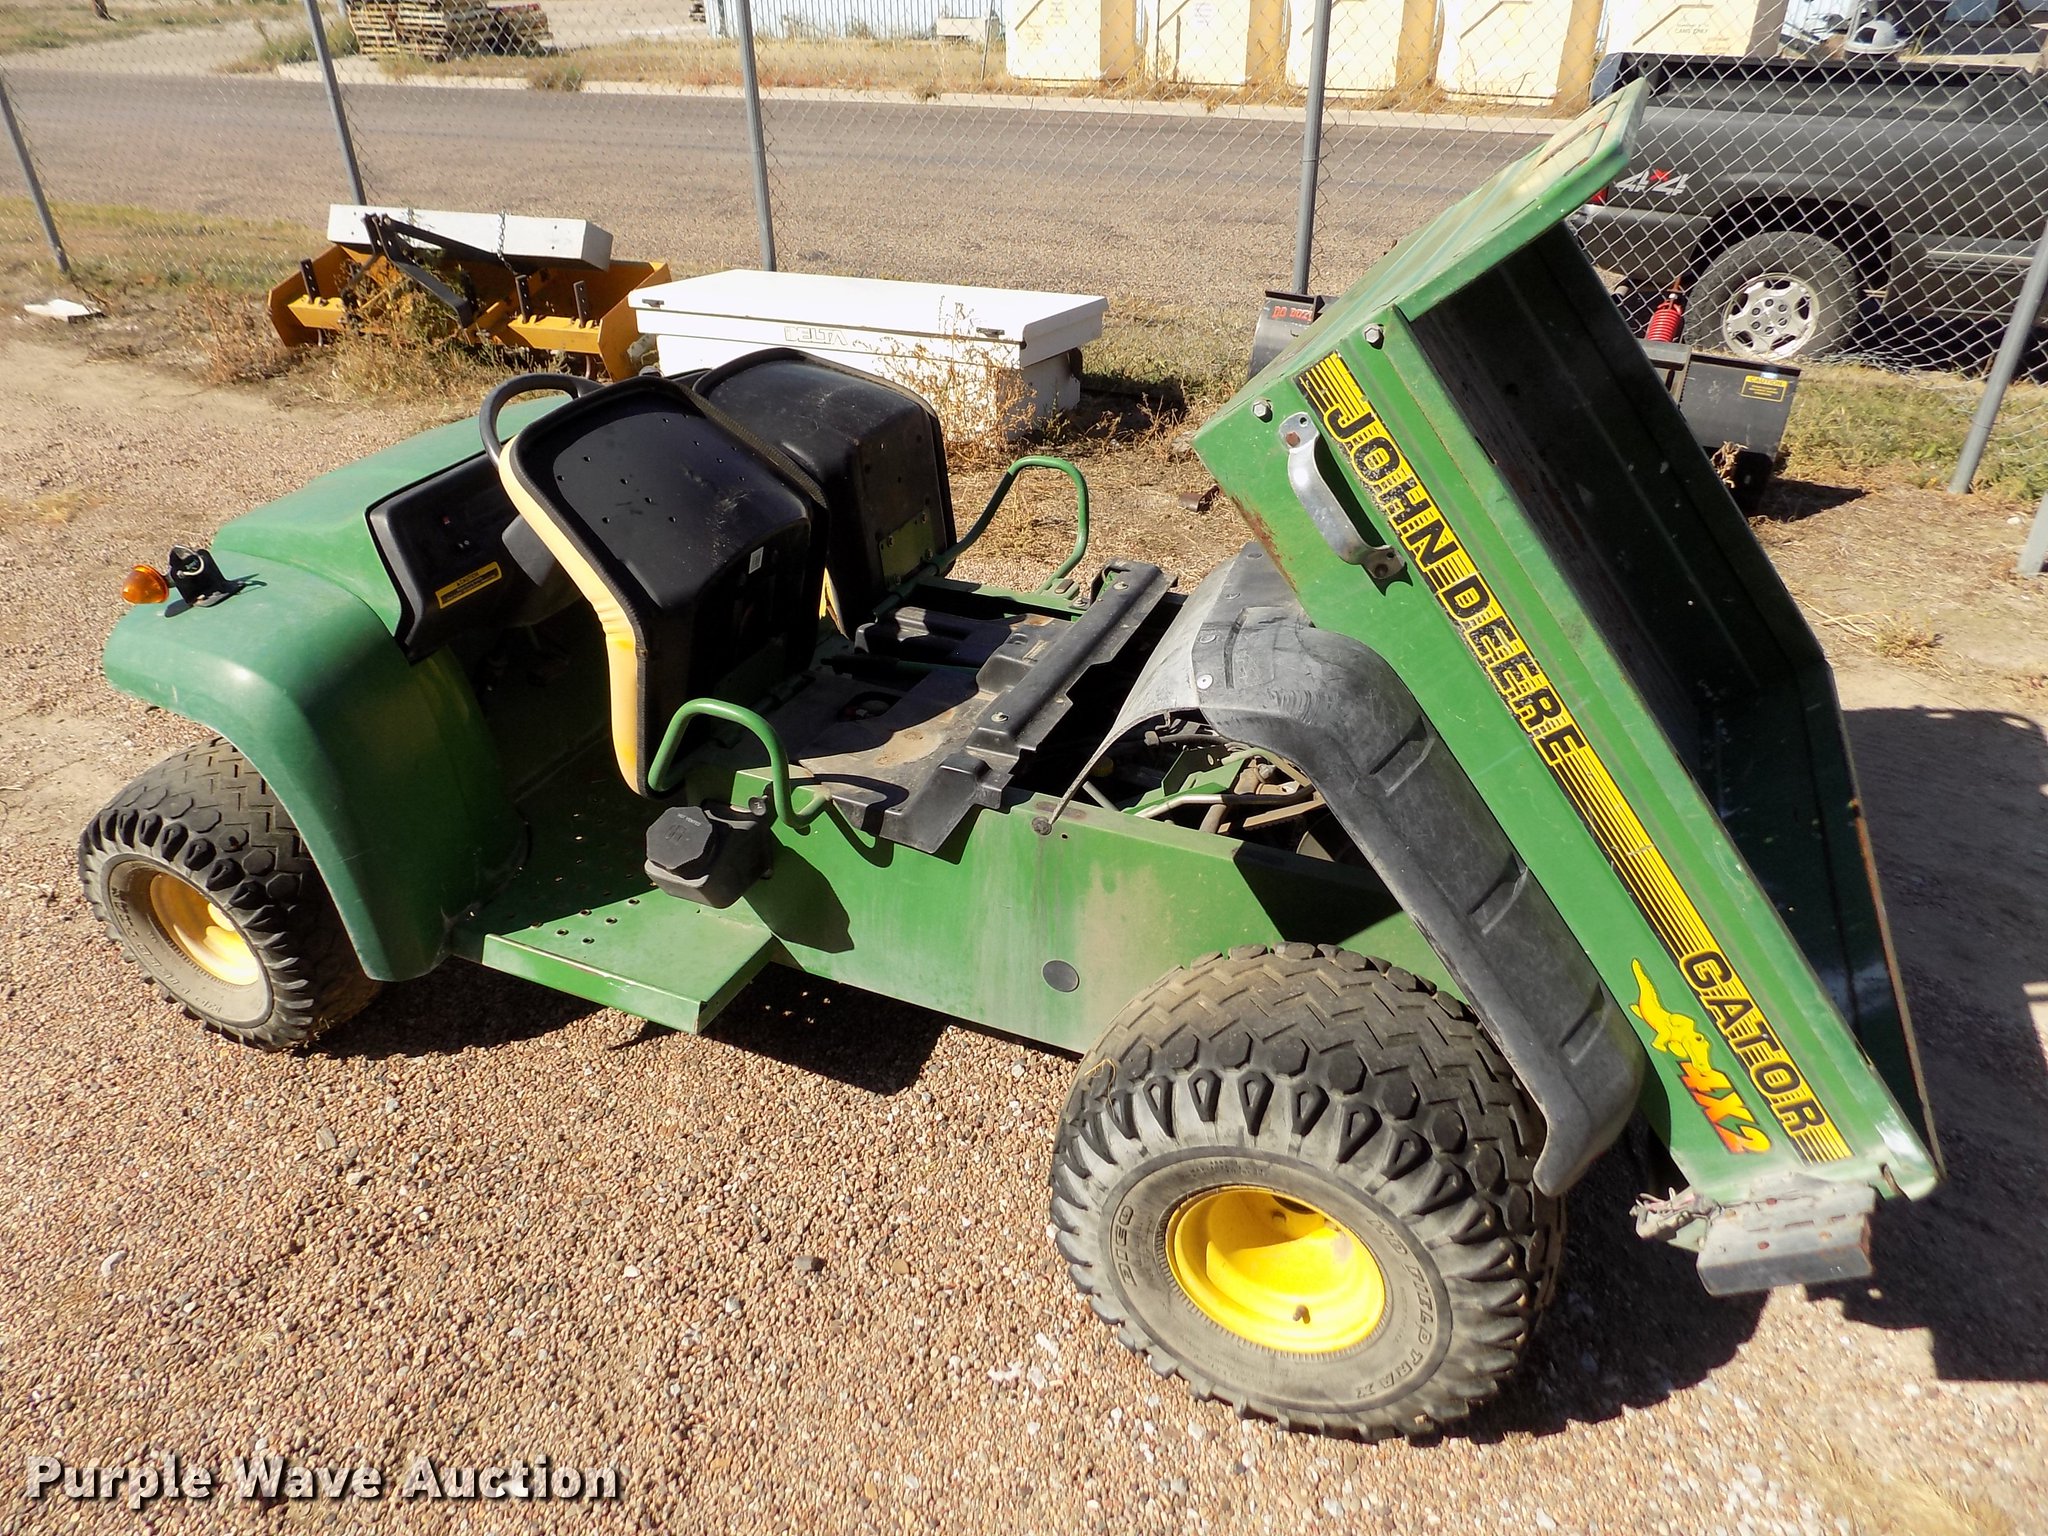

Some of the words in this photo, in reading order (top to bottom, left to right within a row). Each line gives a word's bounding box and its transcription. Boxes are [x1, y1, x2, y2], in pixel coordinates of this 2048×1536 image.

[784, 326, 848, 346] DELTA
[1323, 406, 1459, 572] JOHN
[1438, 572, 1586, 765] DEERE
[1679, 950, 1827, 1136] GATOR
[1401, 1263, 1434, 1345] FIELD
